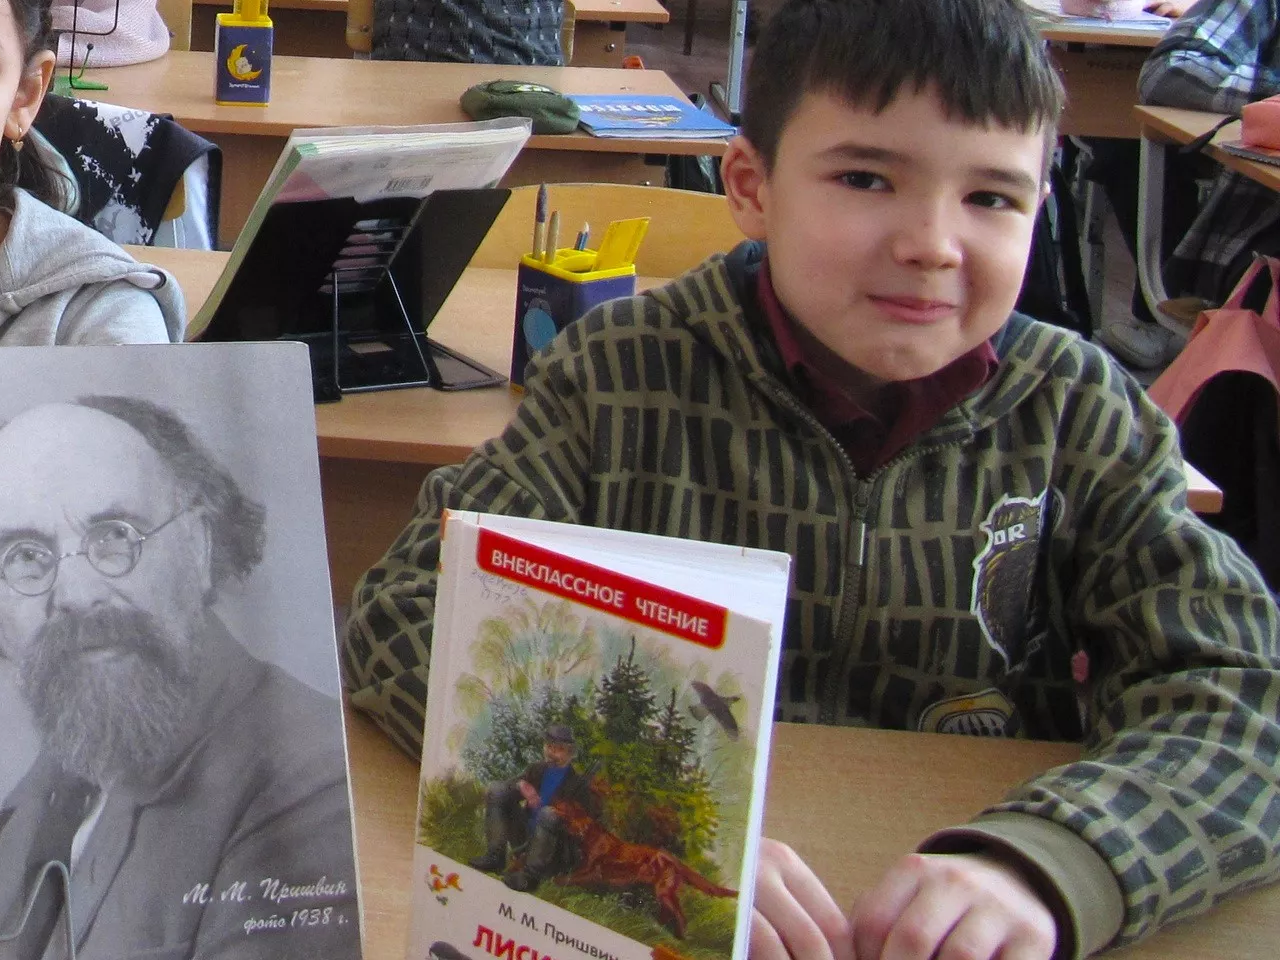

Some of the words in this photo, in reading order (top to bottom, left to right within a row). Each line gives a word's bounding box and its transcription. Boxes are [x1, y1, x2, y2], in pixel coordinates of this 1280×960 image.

[491, 549, 625, 609] ВНЕКЛАССНОЕ
[635, 596, 710, 638] ЧТЕНИЕ
[182, 882, 214, 906] М.
[221, 881, 251, 903] М.
[257, 876, 348, 903] Пришвин
[243, 914, 287, 935] фото
[291, 908, 333, 929] 1938
[497, 902, 516, 922] М.
[521, 912, 539, 933] М.
